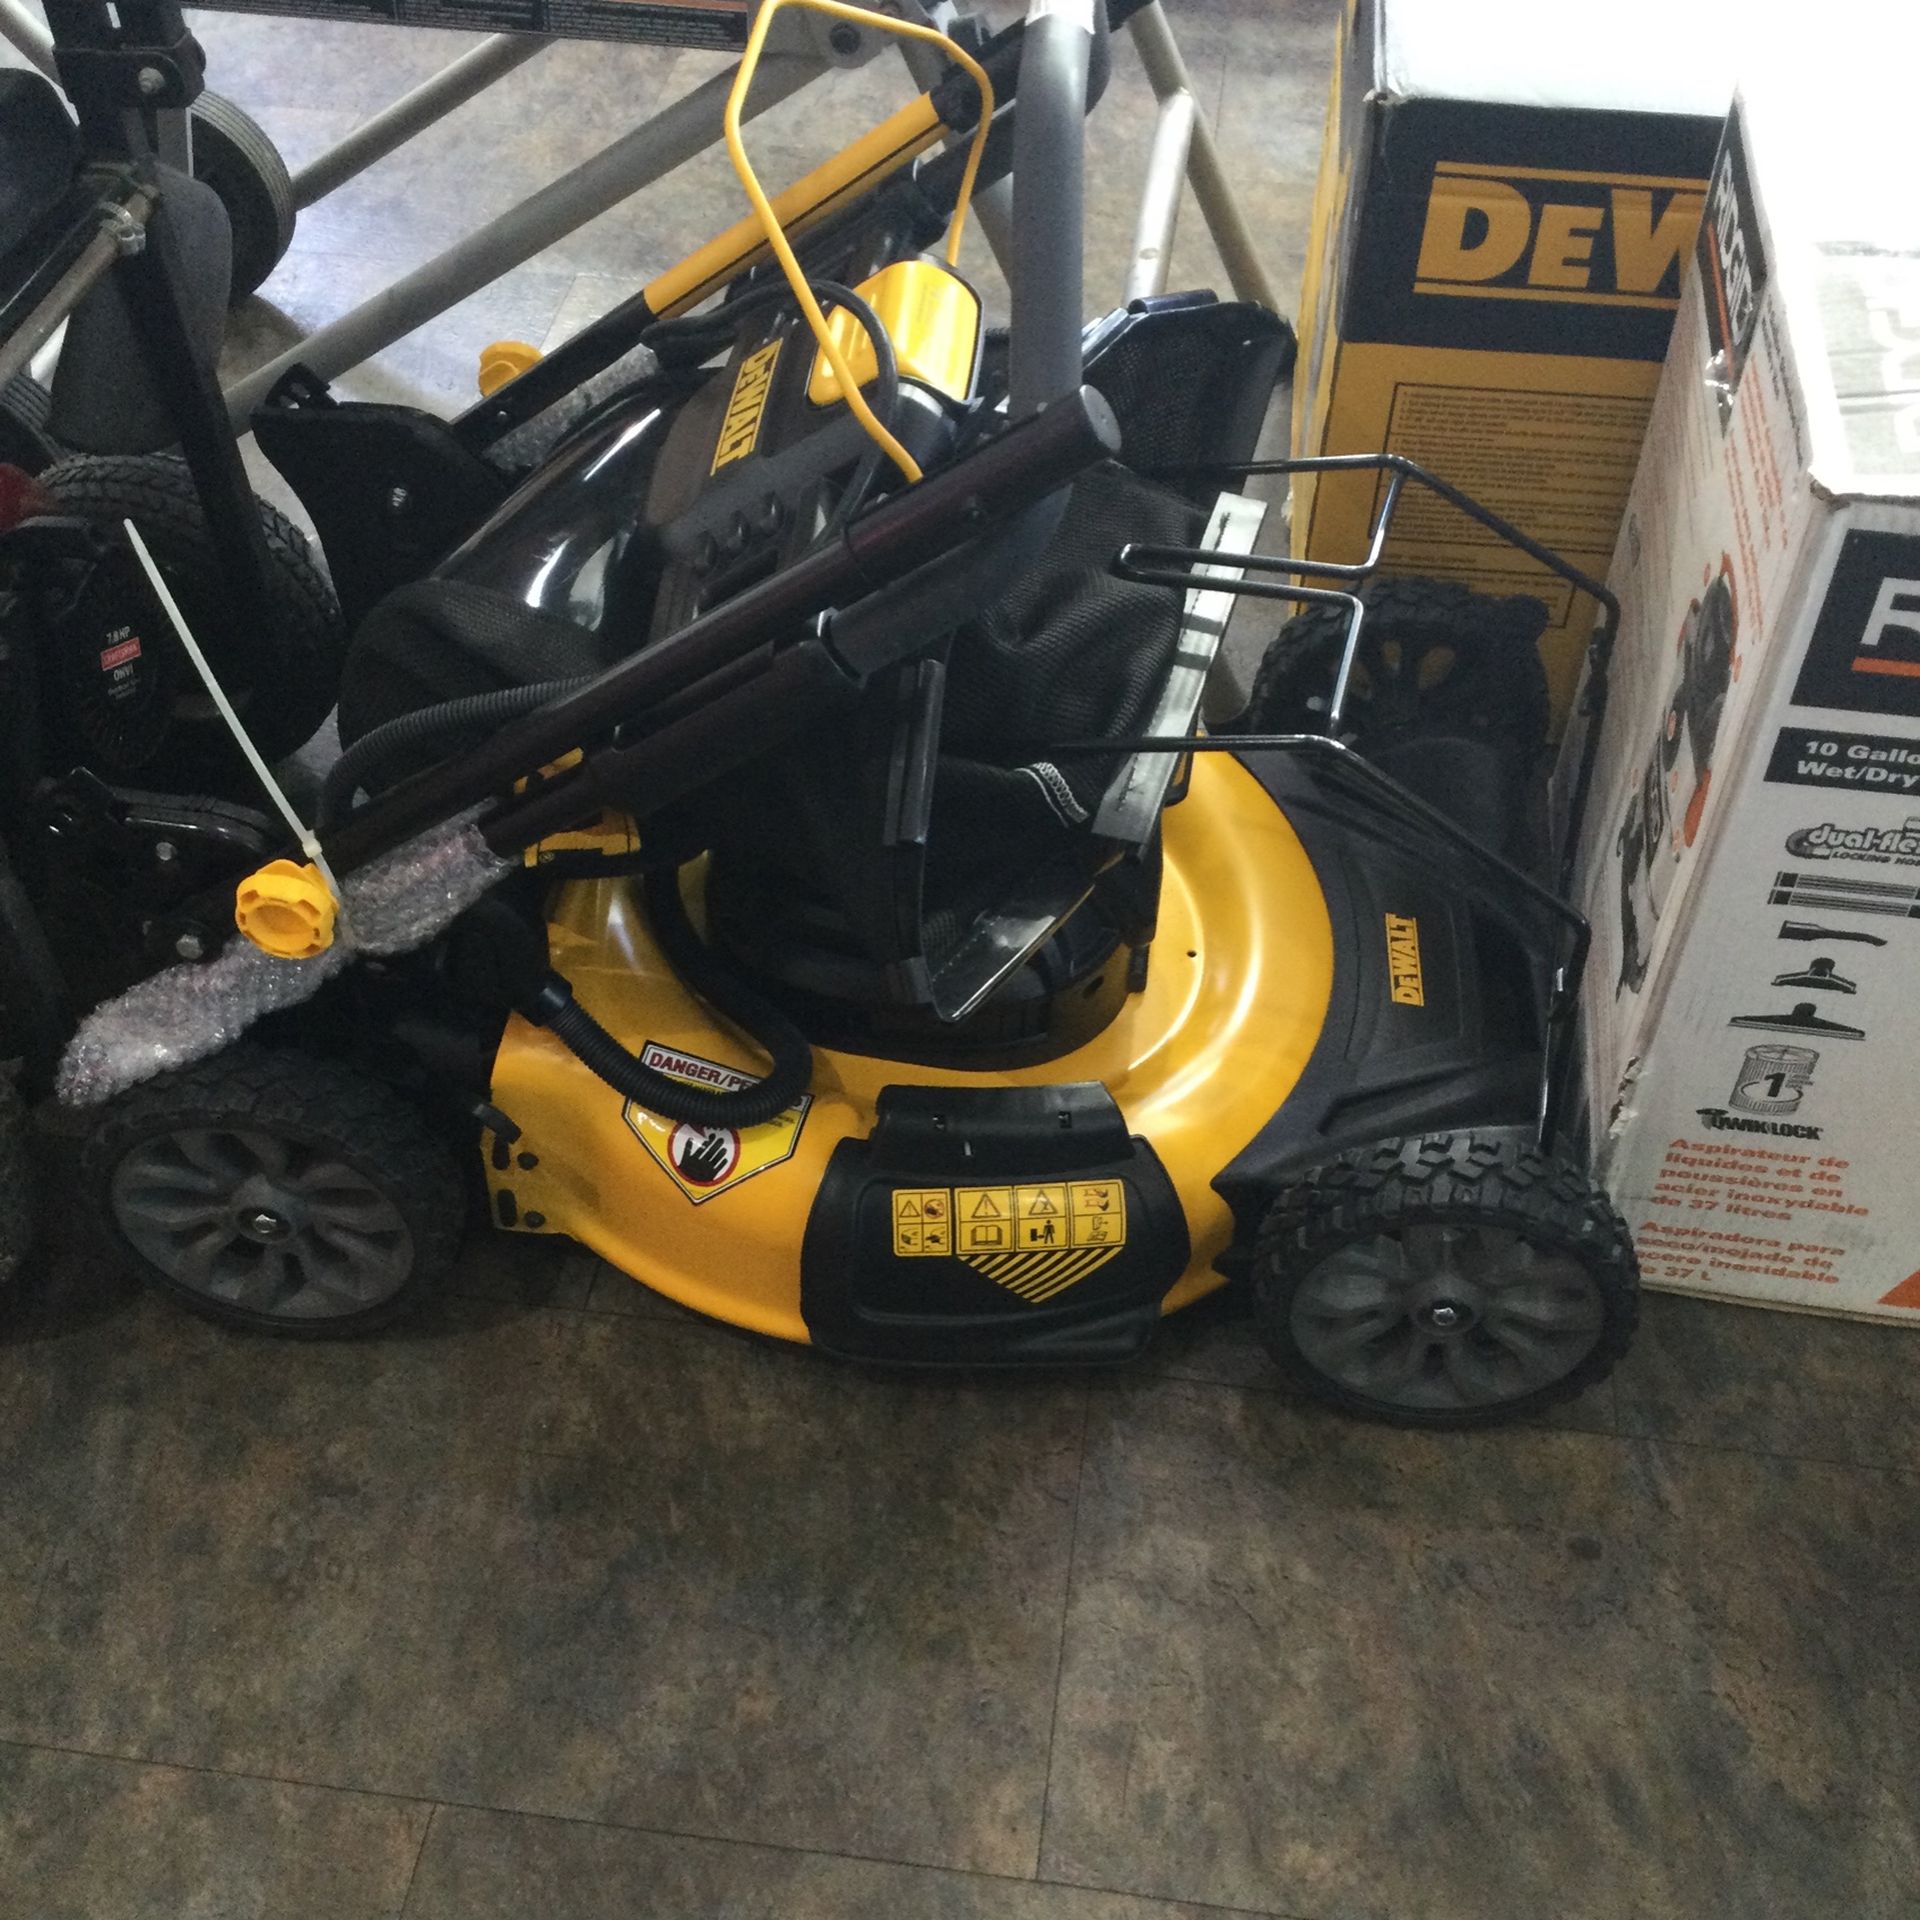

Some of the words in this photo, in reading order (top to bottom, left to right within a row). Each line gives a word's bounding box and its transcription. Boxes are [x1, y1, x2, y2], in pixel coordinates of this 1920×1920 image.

[1806, 741, 1839, 756] 10
[1797, 760, 1920, 788] Wet/Dry
[1807, 824, 1920, 855] dual-fle
[1388, 913, 1421, 1005] DEWALT
[1764, 1072, 1786, 1098] 1
[1665, 1152, 1769, 1173] liquides
[1776, 1167, 1802, 1178] et
[1809, 1170, 1841, 1182] de
[1669, 1139, 1811, 1163] Aspirateur
[1818, 1156, 1850, 1169] de
[1654, 1183, 1720, 1196] acier
[1727, 1188, 1869, 1215] inoxydable
[1811, 1187, 1843, 1198] en
[1650, 1195, 1681, 1207] de
[1688, 1198, 1719, 1210] 37
[1726, 1203, 1792, 1220] litres
[1640, 1221, 1780, 1247] Aspiradora
[1788, 1242, 1846, 1256] para
[1664, 1266, 1694, 1279] 37
[1701, 1270, 1713, 1281] L
[1708, 1257, 1840, 1284] inoxidable
